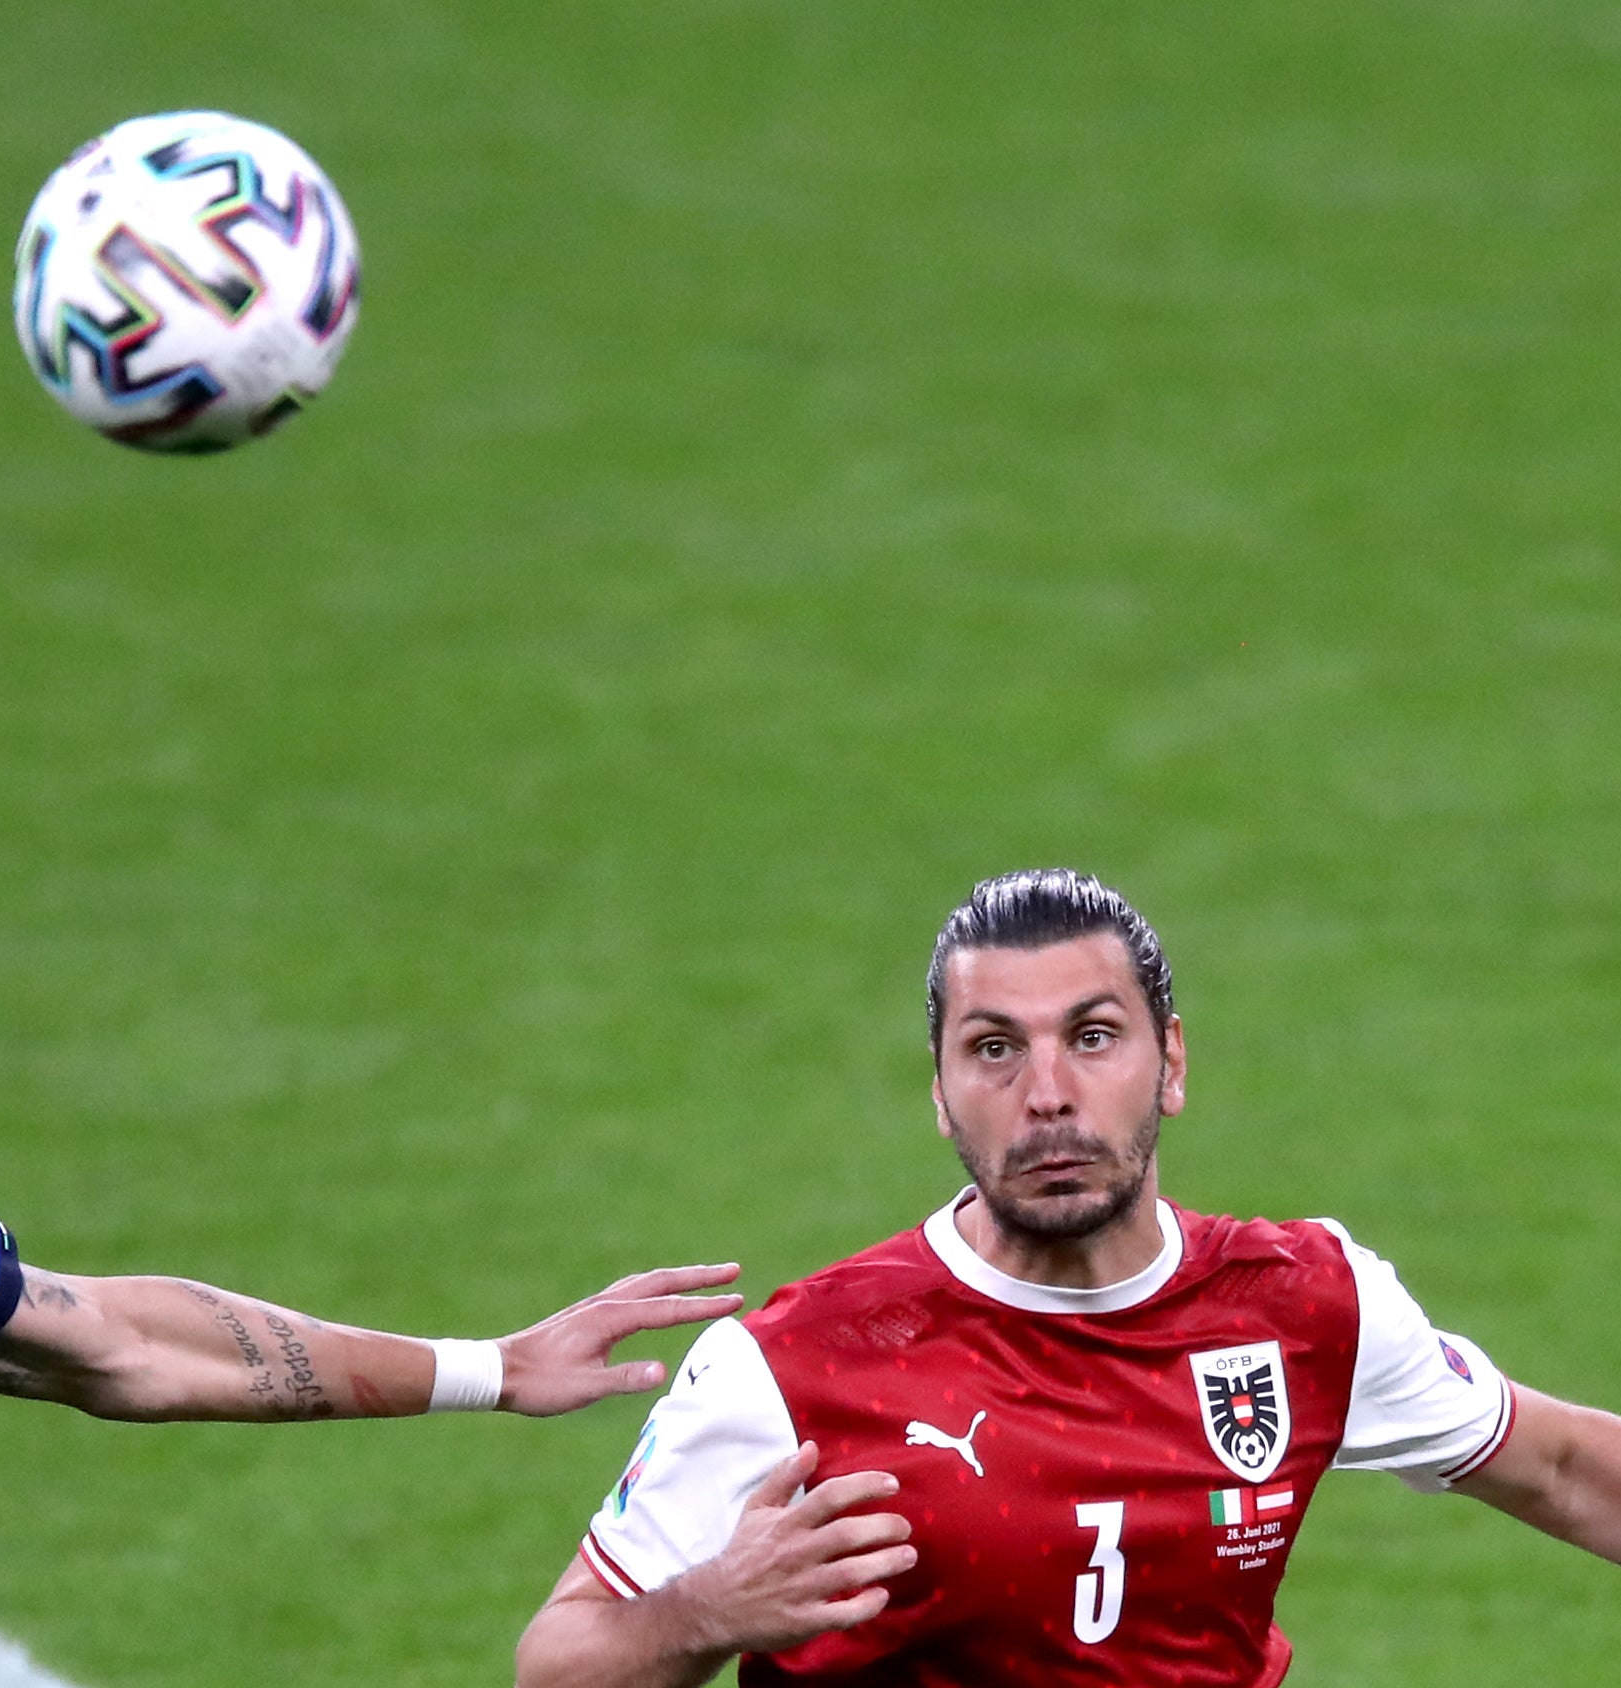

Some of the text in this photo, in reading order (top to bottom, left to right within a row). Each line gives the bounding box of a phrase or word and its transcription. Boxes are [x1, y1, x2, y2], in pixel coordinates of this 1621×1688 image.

[1216, 1355, 1252, 1371] ÖFB
[1243, 1525, 1261, 1539] Juni
[1263, 1521, 1281, 1536] 2021
[1216, 1543, 1257, 1557] Wembley
[1239, 1557, 1267, 1570] London
[1073, 1501, 1126, 1644] 3
